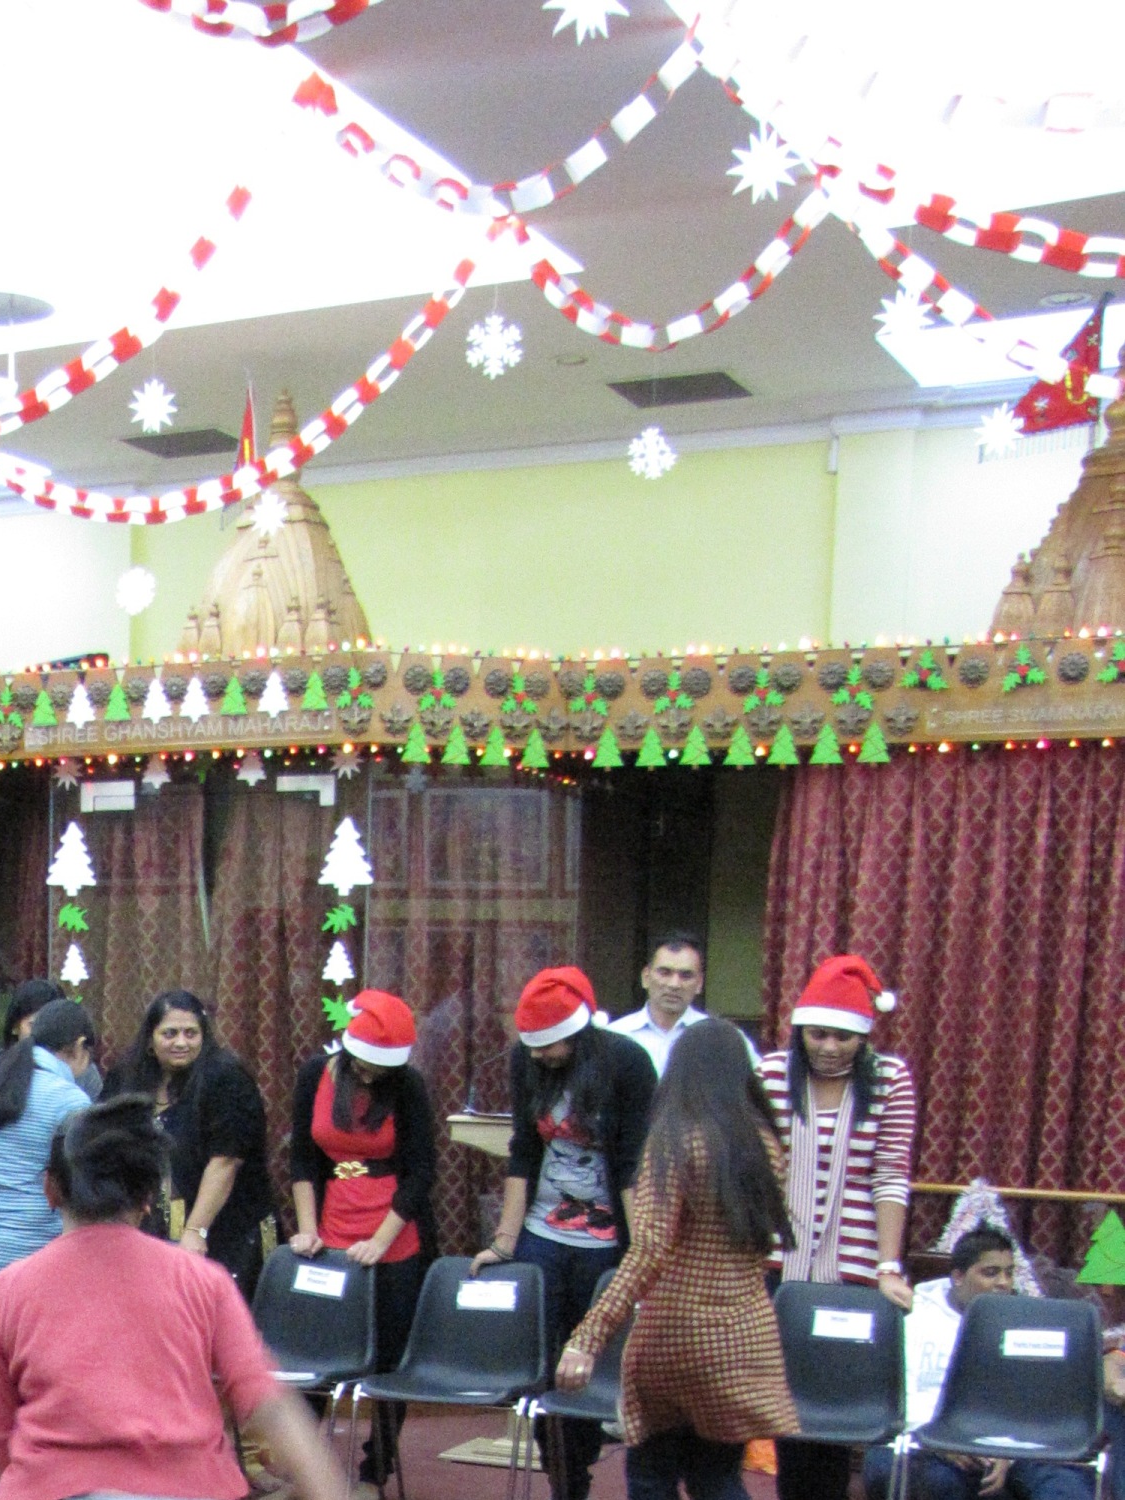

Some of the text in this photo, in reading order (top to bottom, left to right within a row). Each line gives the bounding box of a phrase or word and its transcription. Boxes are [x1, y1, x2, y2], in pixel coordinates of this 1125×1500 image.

[37, 715, 322, 745] SHREE GHANSHYAM MAHARAJ
